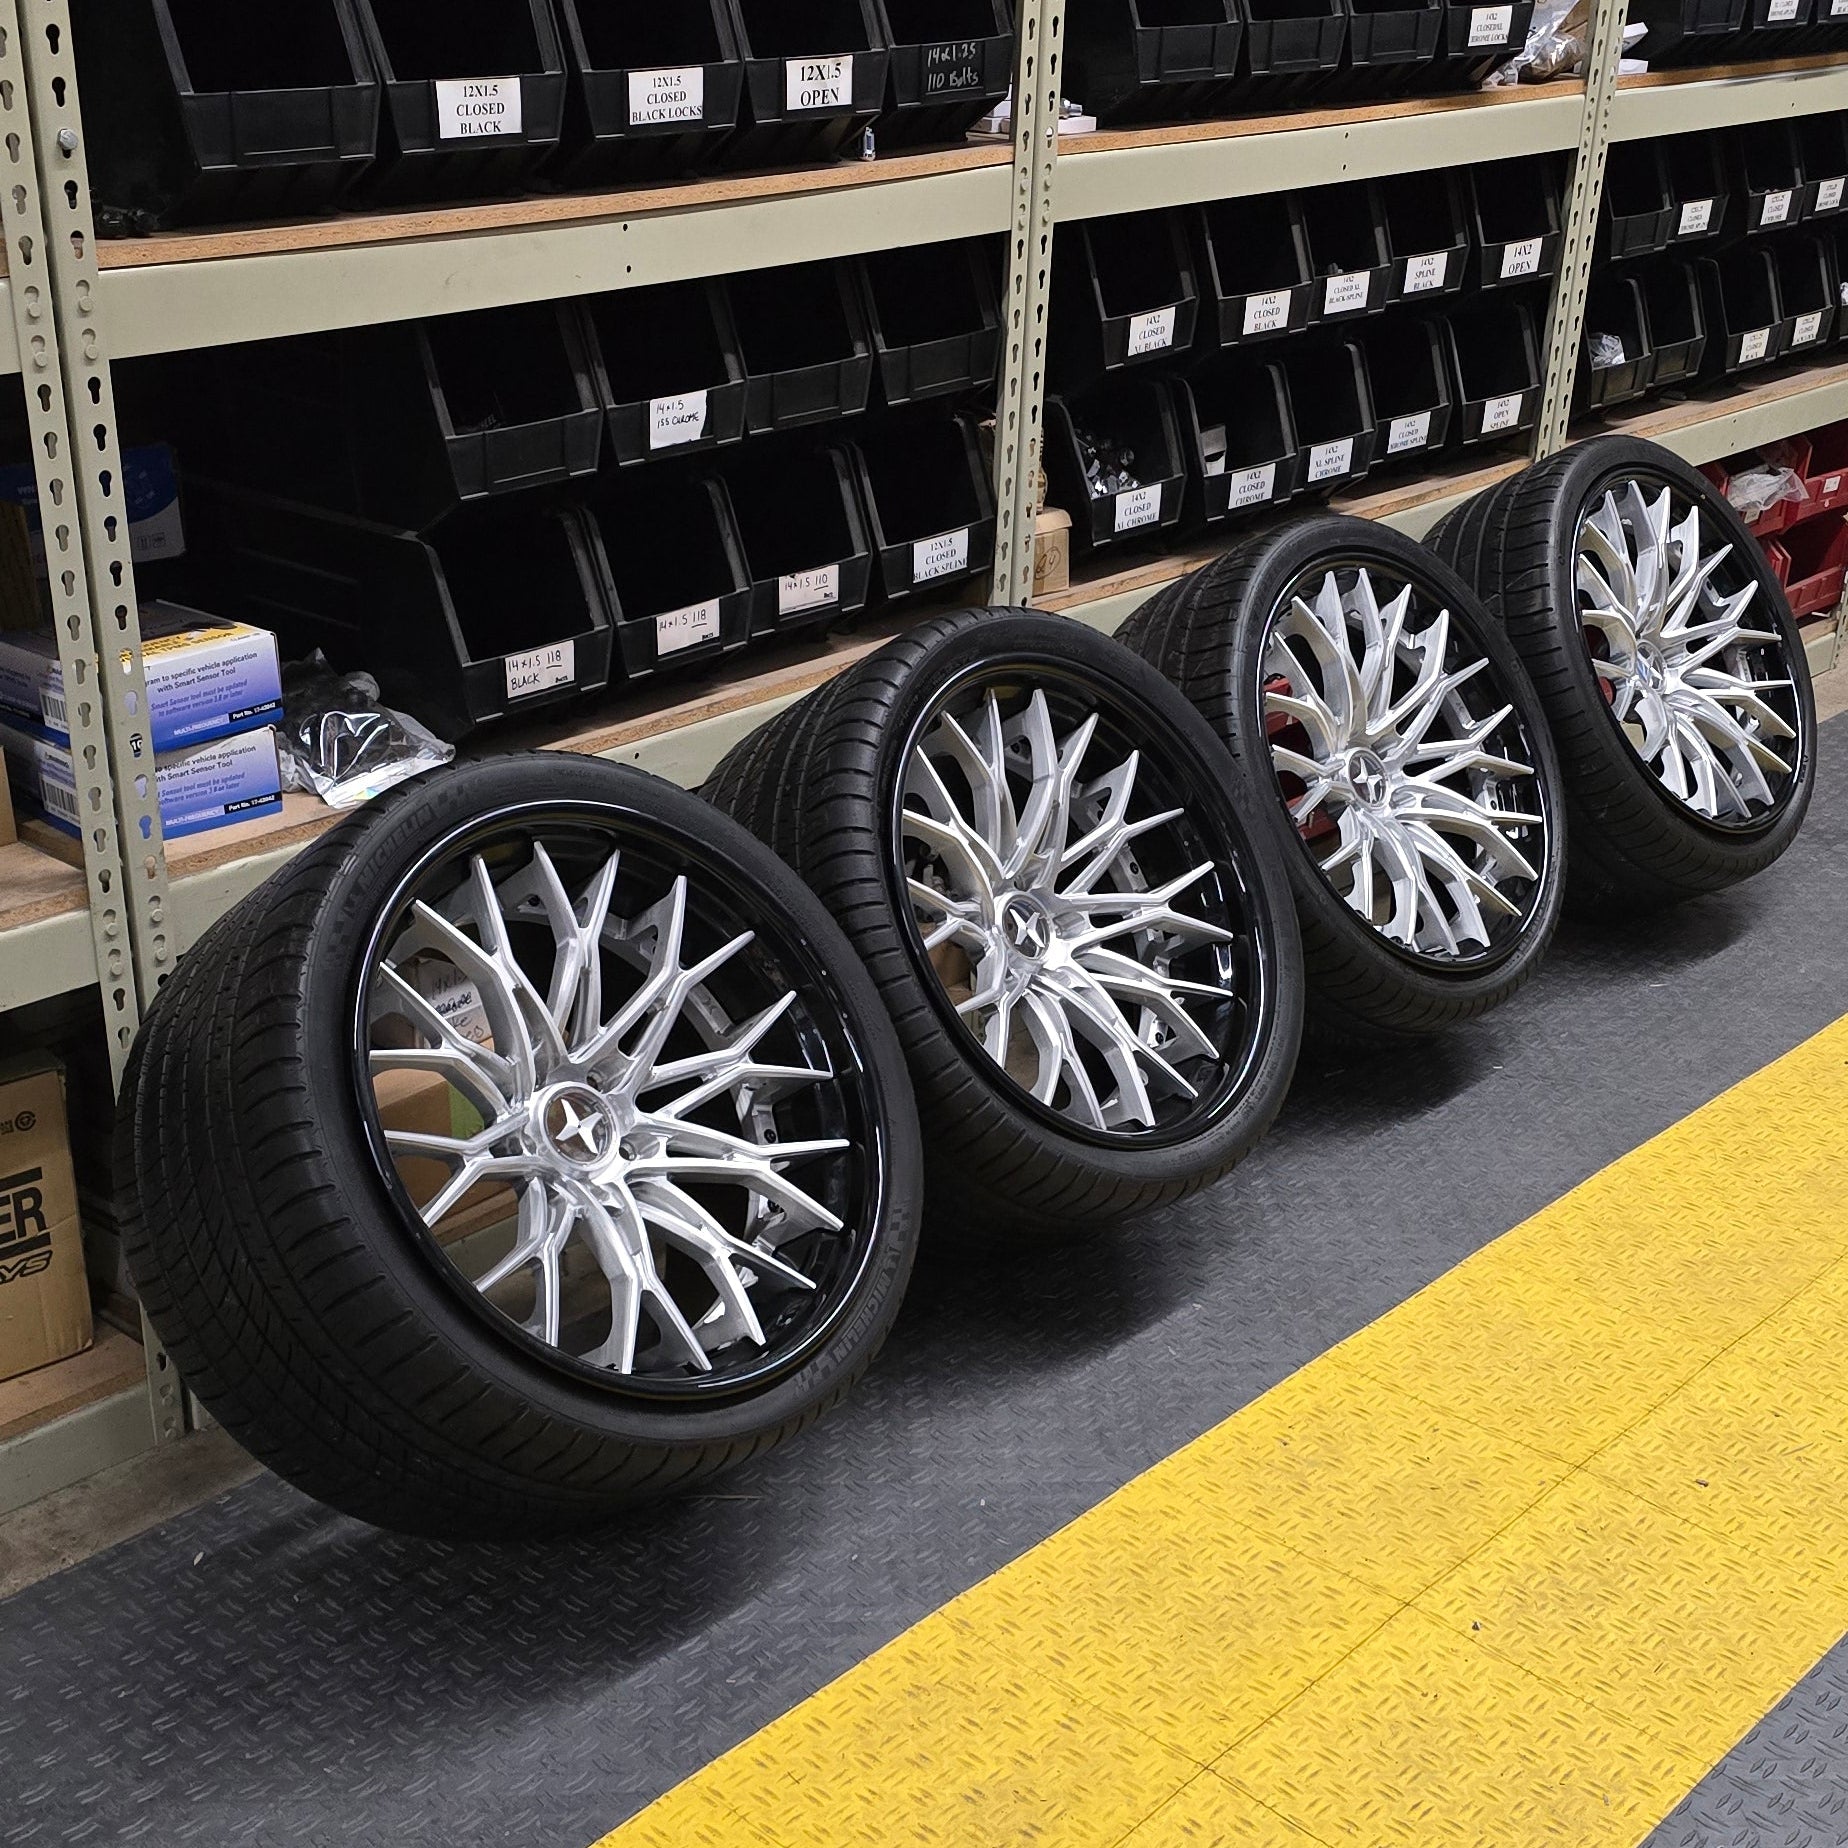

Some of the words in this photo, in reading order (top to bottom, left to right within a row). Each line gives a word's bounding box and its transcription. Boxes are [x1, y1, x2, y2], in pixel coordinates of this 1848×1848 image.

[801, 63, 842, 82] 12X1.5
[927, 72, 945, 91] 110
[949, 66, 979, 88] Bolts
[653, 75, 682, 88] 12X1.5
[463, 84, 498, 97] 12X1.5
[801, 88, 840, 107] OPEN
[647, 91, 687, 106] CLOSED
[456, 102, 505, 117] CLOSED
[632, 108, 666, 123] BLACK
[668, 105, 703, 119] LOCKS
[460, 120, 502, 134] BLACK
[1513, 243, 1532, 258] 14X2
[1414, 267, 1437, 280] SPLINE
[1508, 260, 1532, 275] OPEN
[1253, 306, 1281, 320] CLOSED
[1138, 325, 1166, 341] CLOSED
[1253, 319, 1278, 332] BLACK
[1144, 337, 1168, 352] BLACK
[1493, 409, 1509, 420] OPEN
[1398, 428, 1419, 440] CLOSED
[1323, 454, 1345, 467] SPLINE
[1314, 465, 1342, 479] CHROME
[1238, 480, 1266, 495] CLOSED
[1235, 491, 1265, 507] CHROME
[1124, 502, 1152, 517] CLOSED
[1126, 512, 1157, 528] CHROME
[925, 548, 957, 565] CLOSED
[815, 573, 828, 586] 110
[913, 565, 940, 581] BLACK
[693, 608, 706, 623] 118
[547, 649, 562, 665] 118
[171, 668, 197, 681] specific
[197, 661, 221, 673] vehicle
[221, 652, 258, 668] application
[157, 683, 174, 693] with
[174, 678, 196, 689] Smart
[197, 671, 220, 683] Sensor
[221, 667, 236, 677] Tool
[225, 679, 248, 692] updated
[510, 672, 541, 691] BLACK
[164, 759, 191, 773] specific
[192, 754, 217, 766] vehicle
[218, 745, 256, 760] application
[167, 768, 190, 781] Smart
[190, 763, 216, 775] Sensor
[217, 759, 233, 769] Tool
[162, 787, 183, 798] Sensor
[221, 772, 245, 785] updated
[356, 803, 438, 892] MICHELIN
[834, 1270, 892, 1364] MICHELIN
